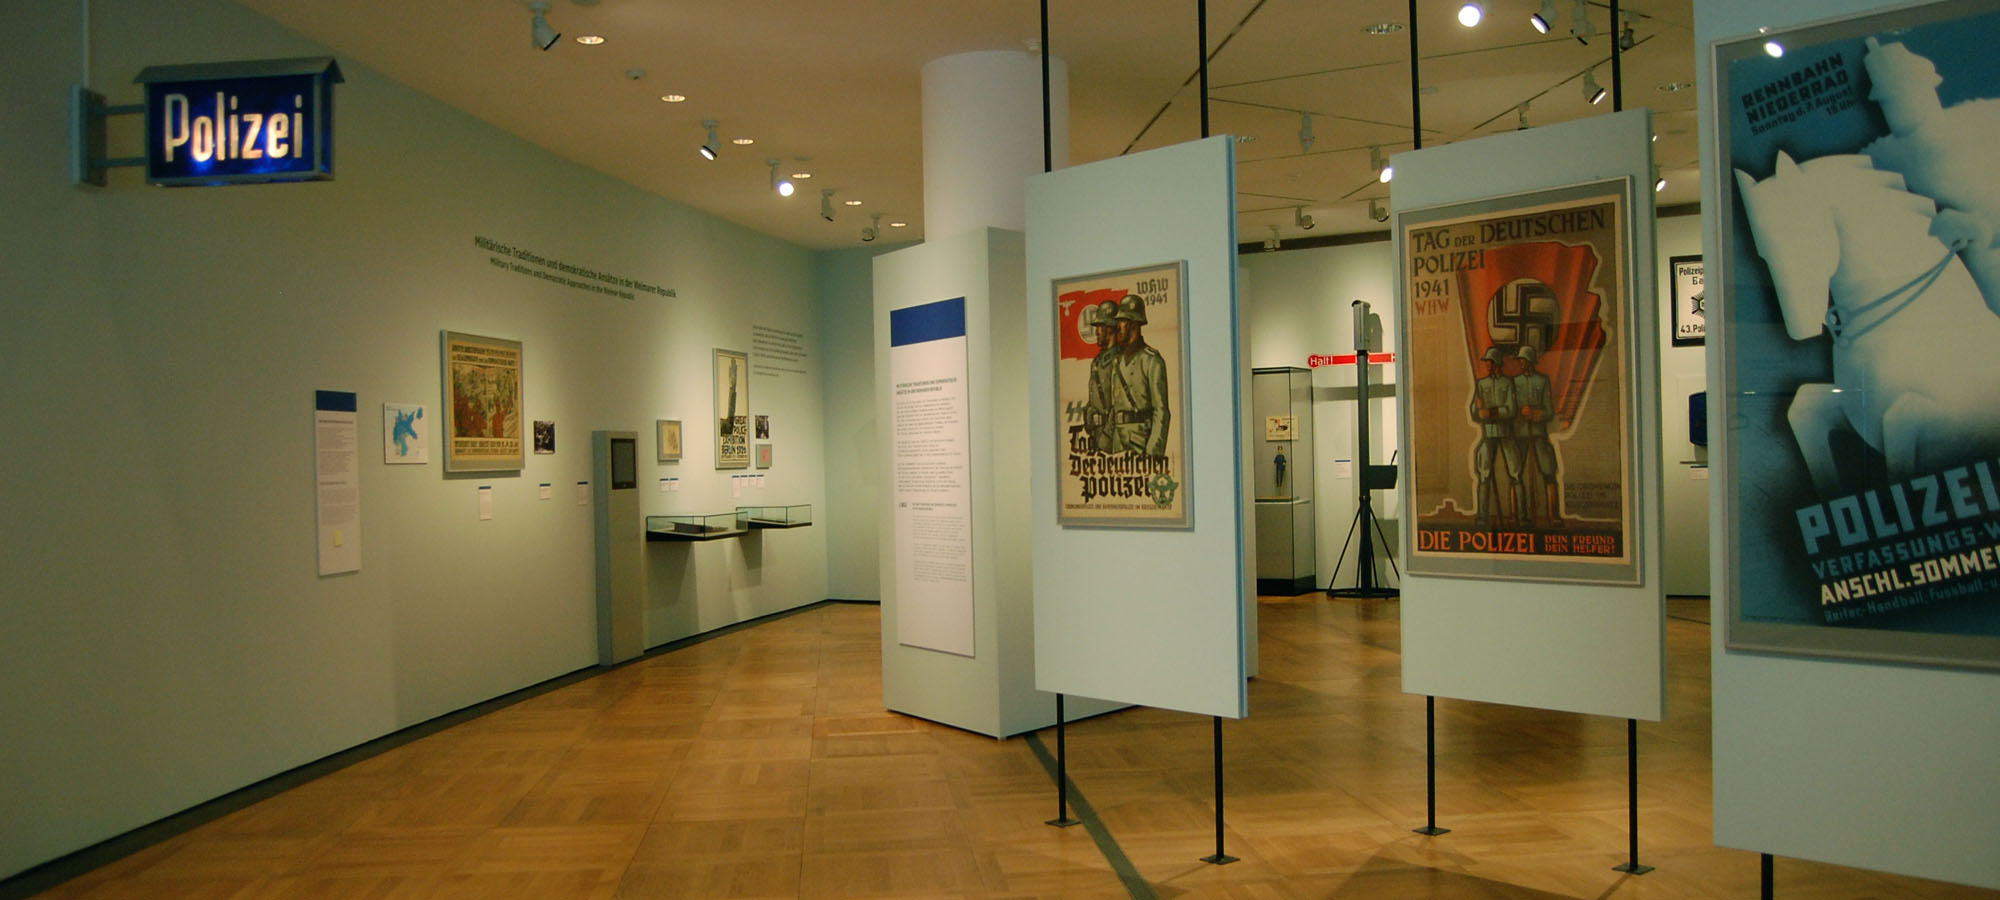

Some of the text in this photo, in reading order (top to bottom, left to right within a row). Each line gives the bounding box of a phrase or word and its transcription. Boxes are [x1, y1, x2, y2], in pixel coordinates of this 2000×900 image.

[1742, 52, 1844, 109] RENNBAHN
[1746, 68, 1849, 124] NIEDERRAD
[1751, 112, 1796, 136] Sonntag
[1815, 84, 1851, 107] August
[165, 92, 303, 162] Polizei
[1412, 208, 1605, 252] TAG DER DEUTSCHEN
[474, 235, 512, 255] Militärische
[512, 246, 546, 266] Traditionen
[546, 259, 558, 270] und
[1413, 249, 1486, 277] POLIZEI
[1145, 293, 1168, 306] 1941
[1415, 278, 1449, 298] 1941
[1415, 298, 1450, 316] WHW
[1796, 457, 2000, 555] POLIZEI
[1420, 530, 1535, 553] DIE POLIZEI
[1544, 534, 1568, 544] DEIN
[1544, 543, 1616, 555] DEIN HELFER!
